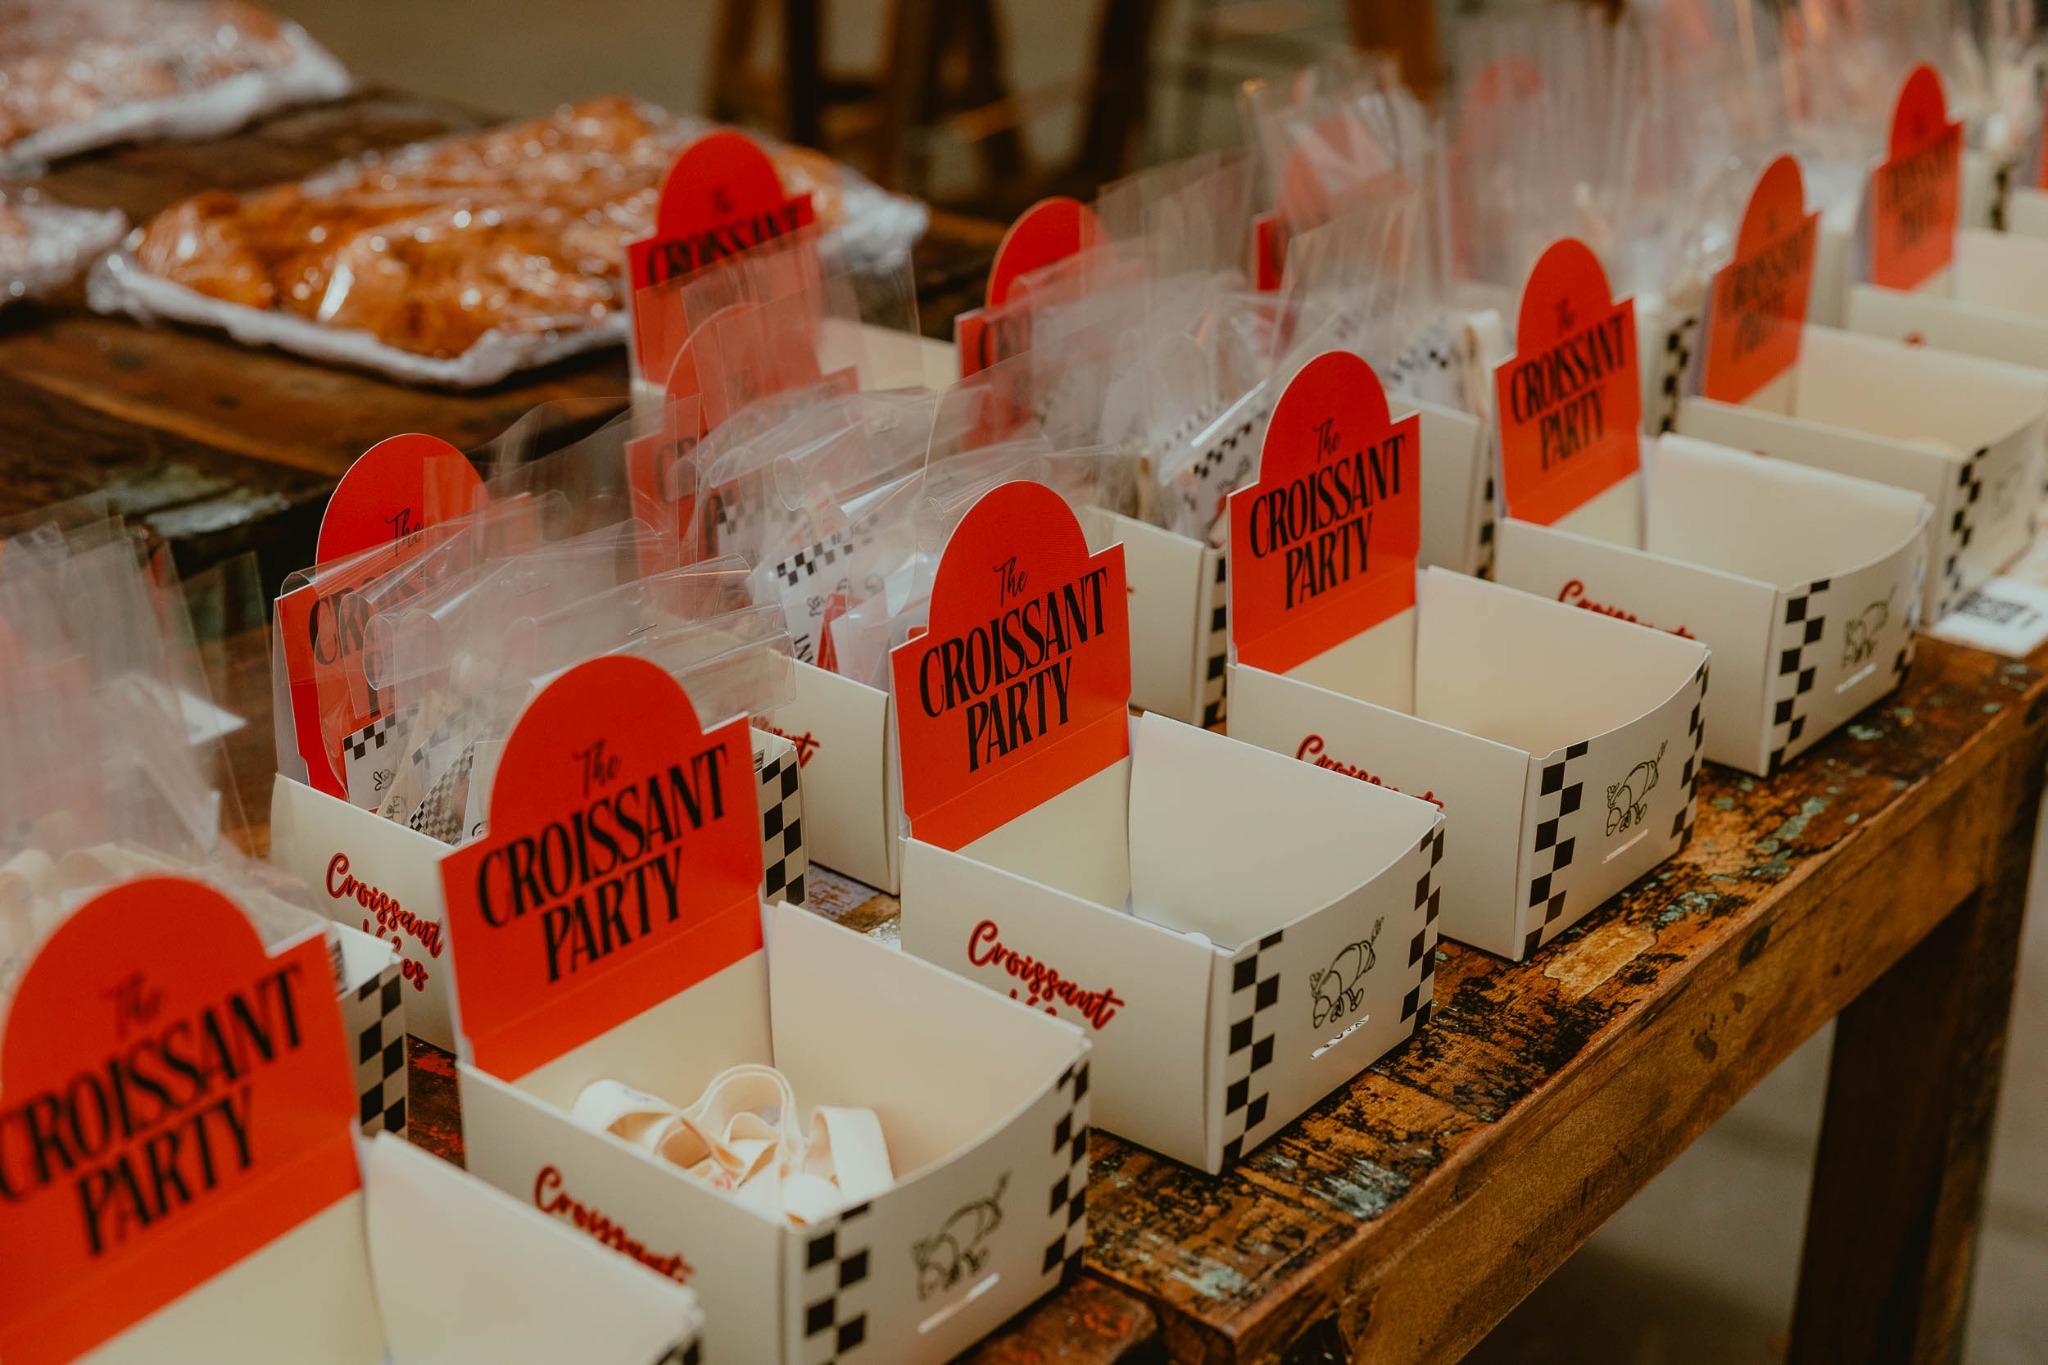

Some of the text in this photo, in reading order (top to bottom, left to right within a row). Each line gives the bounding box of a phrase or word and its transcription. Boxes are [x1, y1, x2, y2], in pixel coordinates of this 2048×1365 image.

[1510, 311, 1624, 425] CROISSANT
[1313, 418, 1340, 463] The
[1540, 385, 1604, 471] PARTY
[385, 508, 424, 557] The
[1250, 433, 1405, 559] CROISSANT
[993, 556, 1029, 608] The
[1285, 511, 1373, 611] PARTY
[919, 566, 1109, 718] CROISSANT
[572, 739, 622, 797] The
[966, 656, 1072, 774] PARTY
[476, 743, 729, 929] CROISSANT
[326, 852, 444, 959] Croissant
[541, 846, 682, 984] PARTY
[968, 919, 1126, 1031] Croissant
[0, 963, 303, 1205] CROISSANT
[77, 1084, 250, 1256] PARTY
